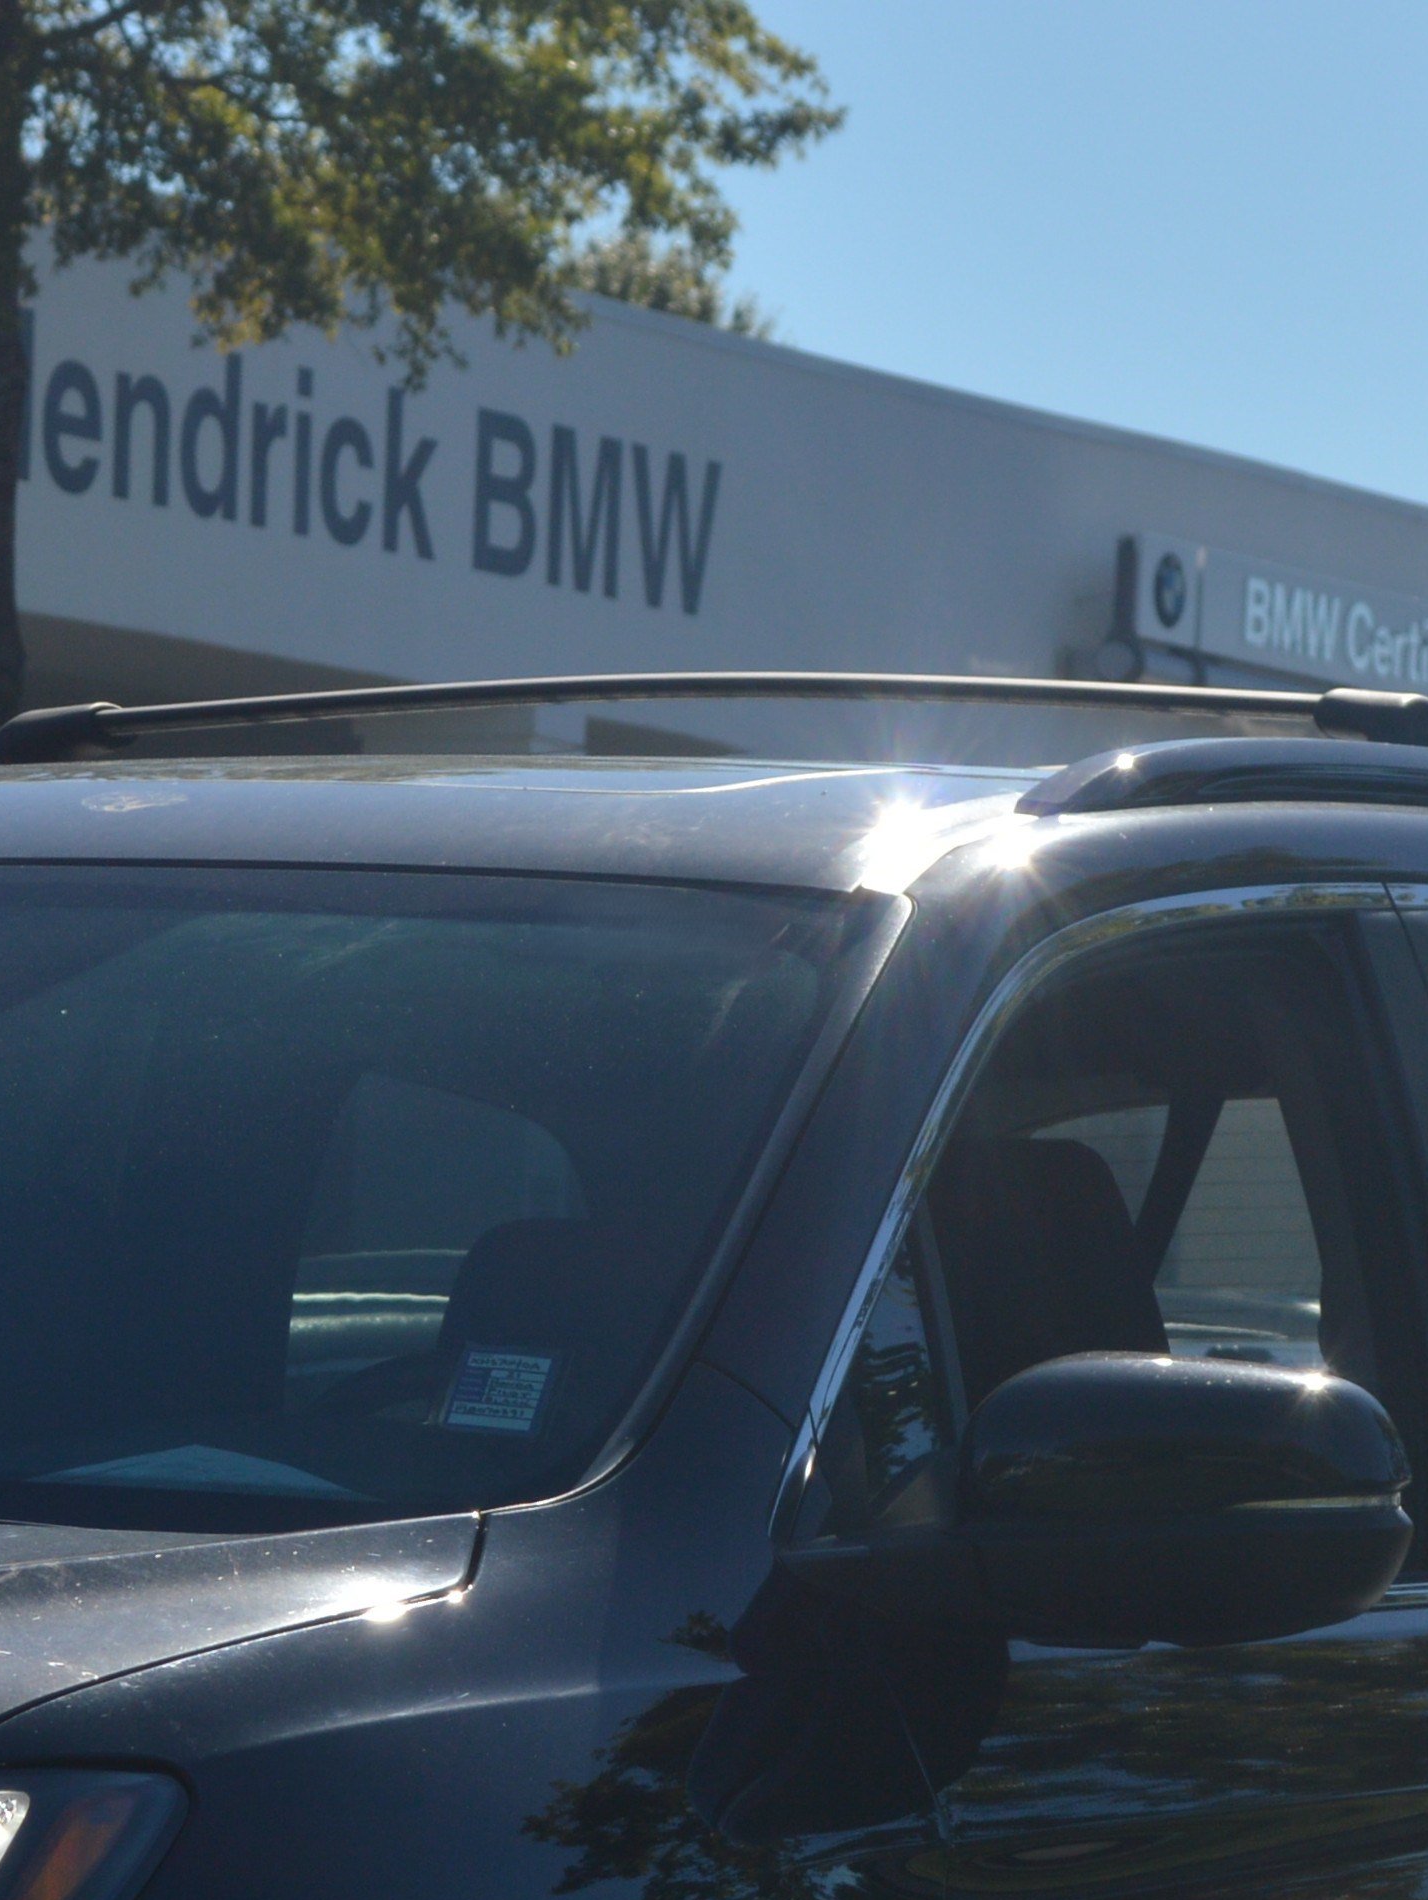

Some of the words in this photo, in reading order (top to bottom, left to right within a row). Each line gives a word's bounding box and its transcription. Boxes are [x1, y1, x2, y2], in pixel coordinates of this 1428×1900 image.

[16, 308, 438, 561] endrick
[471, 407, 723, 616] BMW
[1244, 577, 1343, 661] BMW
